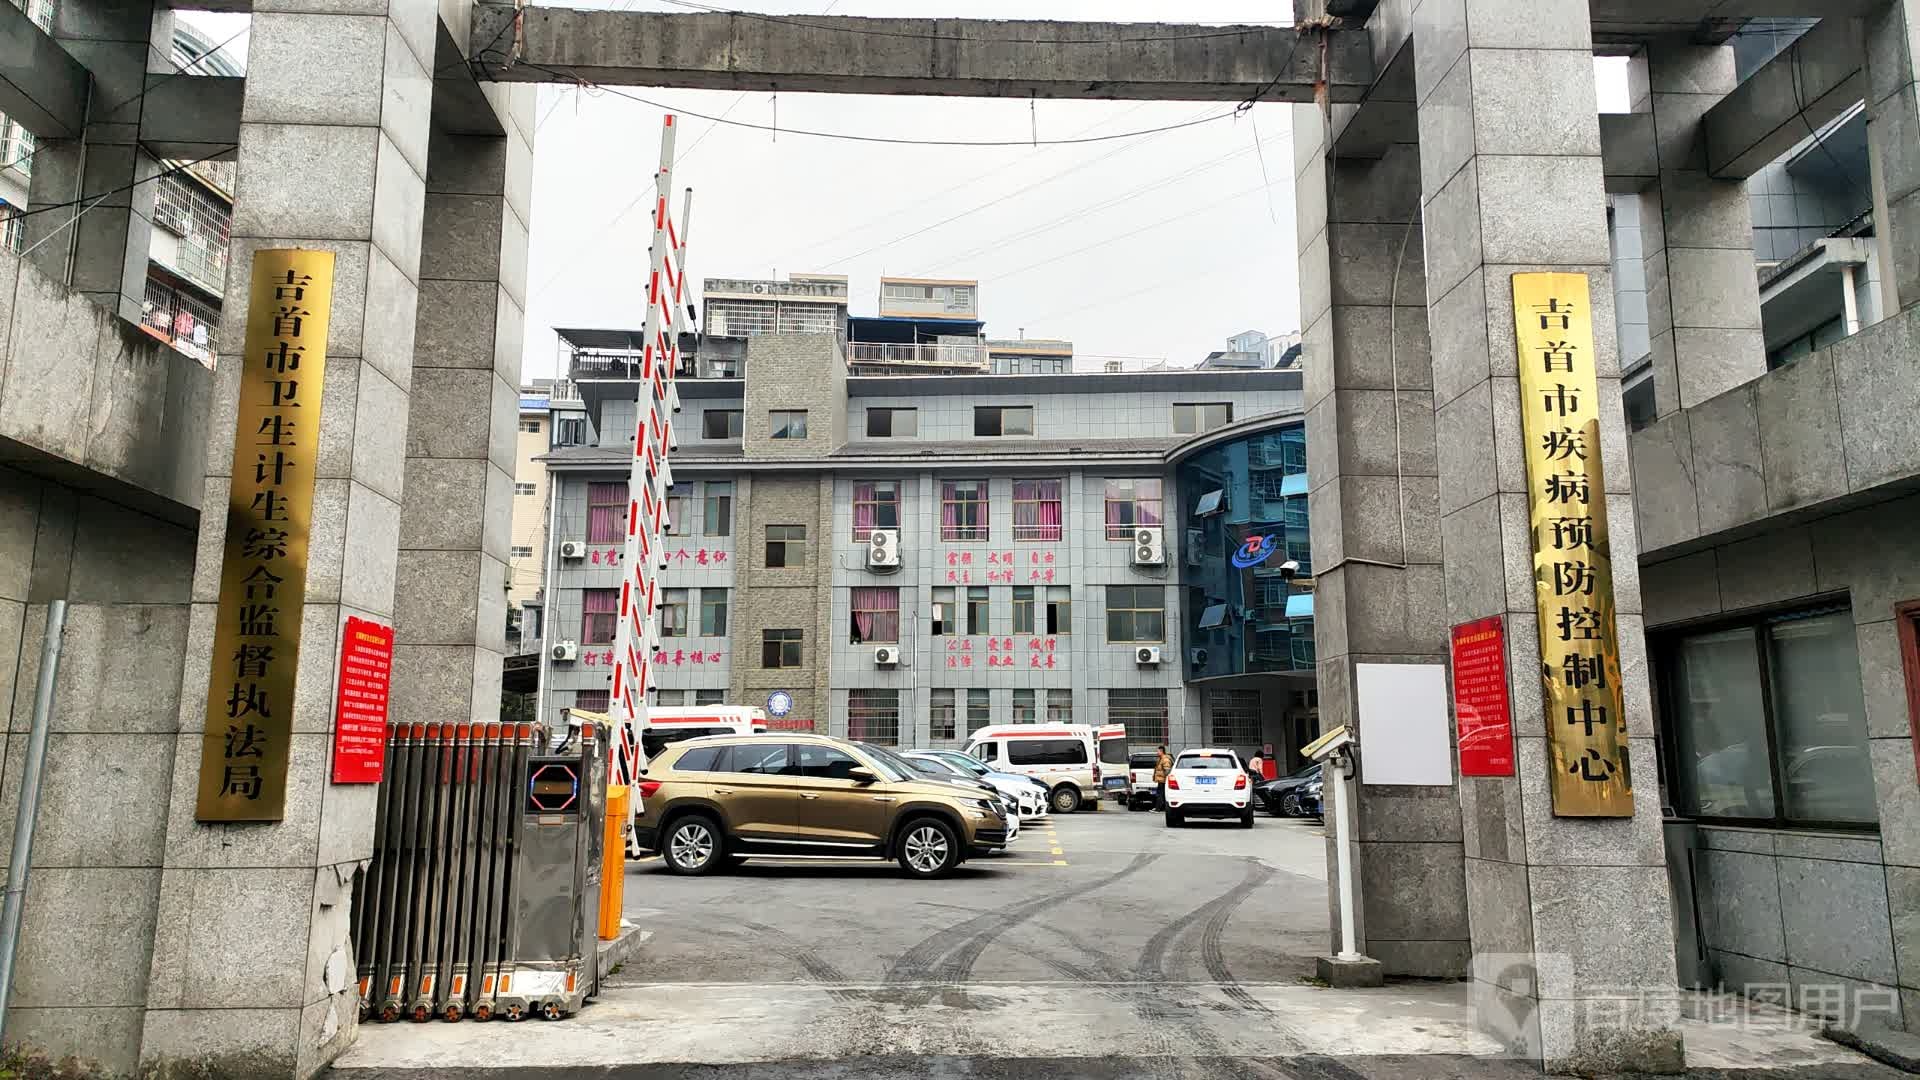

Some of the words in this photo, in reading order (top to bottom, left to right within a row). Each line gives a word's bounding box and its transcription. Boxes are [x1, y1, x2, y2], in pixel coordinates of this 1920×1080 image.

[219, 269, 312, 800] 吉首市卫生计生综合监督执法局
[1531, 298, 1616, 782] 吉首市疾病预防控制中心
[988, 551, 1013, 565] 文明
[1031, 551, 1055, 564] 自由
[947, 569, 971, 584] 民主
[947, 639, 972, 651] 公正
[1029, 637, 1056, 652] 诚信
[583, 648, 722, 667] 打造领导核心
[1030, 653, 1056, 669] 友善
